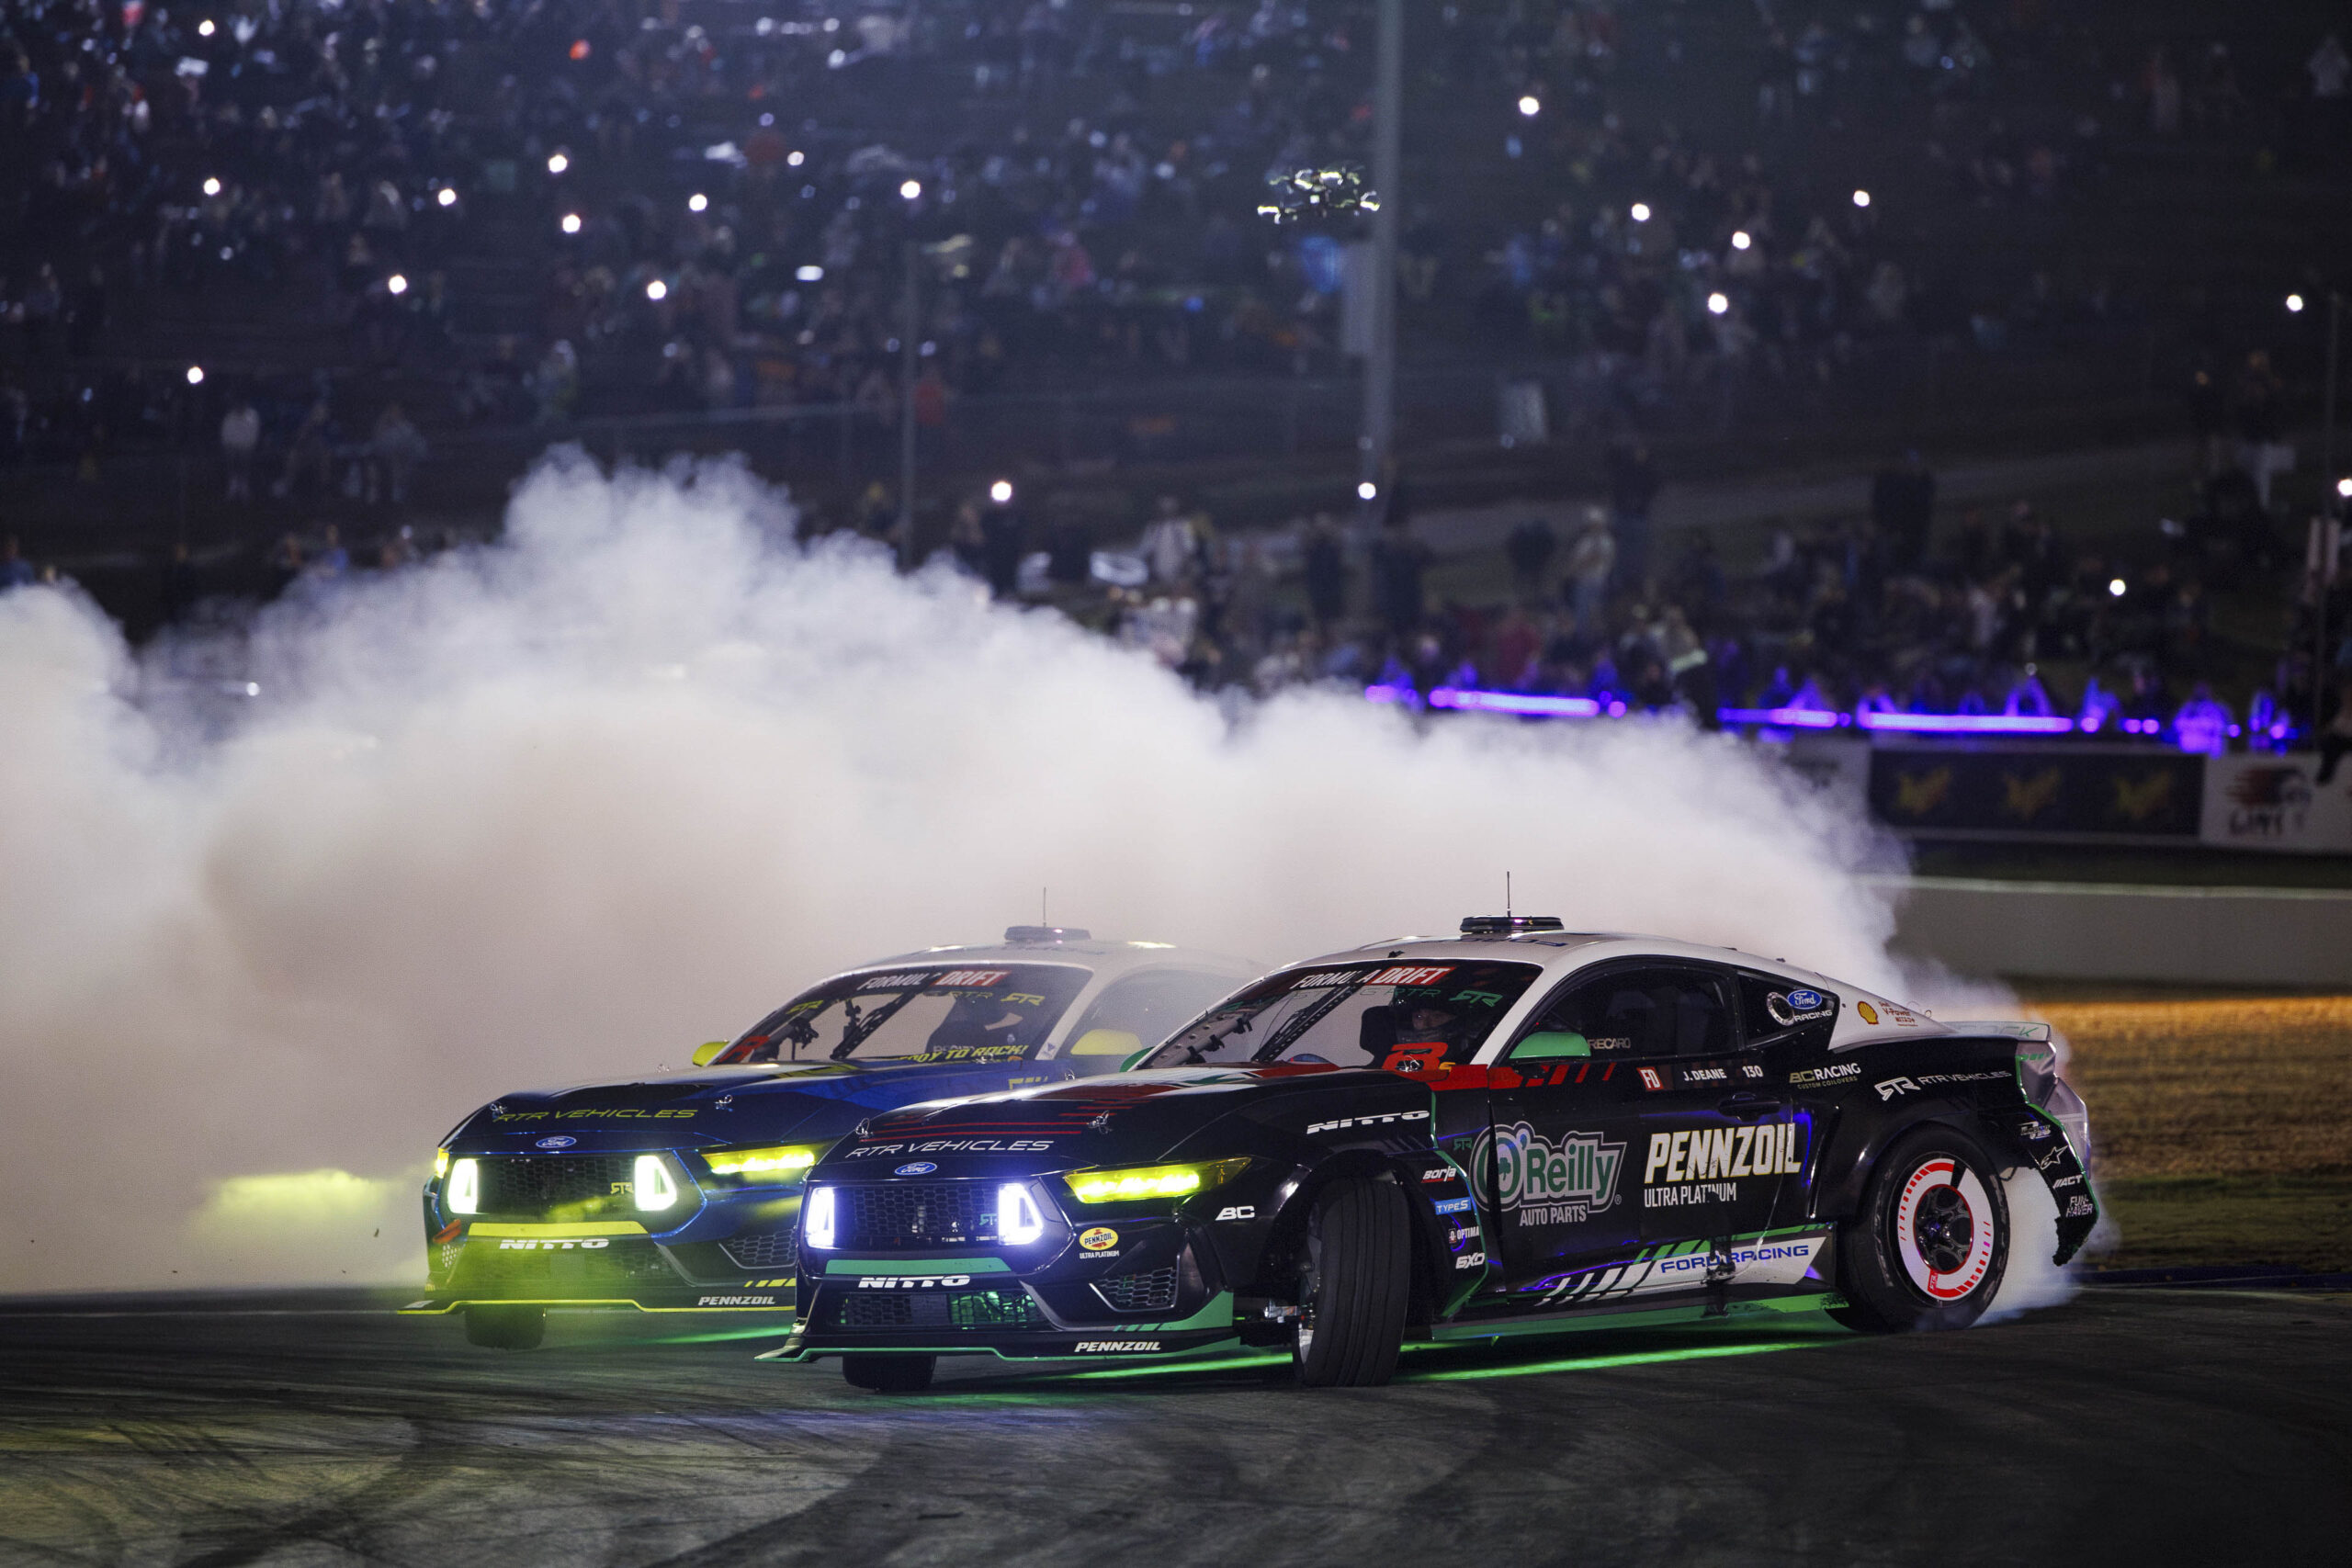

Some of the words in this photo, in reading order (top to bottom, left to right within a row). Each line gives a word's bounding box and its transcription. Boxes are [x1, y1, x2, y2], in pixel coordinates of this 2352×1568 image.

[856, 972, 942, 991] FORMUL
[934, 971, 1007, 986] DRIFT
[1290, 969, 1381, 989] FORMUA
[1373, 967, 1450, 985] DRIFT
[1794, 1010, 1833, 1022] RACING
[945, 1049, 970, 1060] TO
[1640, 1068, 1661, 1089] FD
[1743, 1066, 1763, 1077] 130
[1917, 1076, 1947, 1086] RTR
[1946, 1070, 2013, 1083] VEHICLES
[555, 1109, 698, 1119] VEHICLES
[1306, 1110, 1430, 1134] NITTO
[845, 1144, 905, 1158] RTR
[908, 1140, 1055, 1152] VEHICLES
[1644, 1122, 1802, 1184] PENNZOIL
[1475, 1131, 1617, 1201] O'Reilly
[1644, 1187, 1679, 1208] ULTRA
[1216, 1205, 1255, 1221] BC
[1520, 1208, 1548, 1226] AUTO
[1551, 1205, 1587, 1224] PARTS
[2065, 1203, 2093, 1218] HAVER
[1084, 1233, 1113, 1246] PENNZOIL
[1457, 1226, 1479, 1240] OPTIMA
[499, 1238, 610, 1249] NITTO
[1095, 1250, 1120, 1258] PLATINUM
[1661, 1255, 1721, 1273] FORD
[1726, 1245, 1809, 1264] RACING
[858, 1275, 970, 1288] NITTO
[698, 1296, 775, 1305] PENNZOIL
[1074, 1341, 1162, 1352] PENNZOIL
